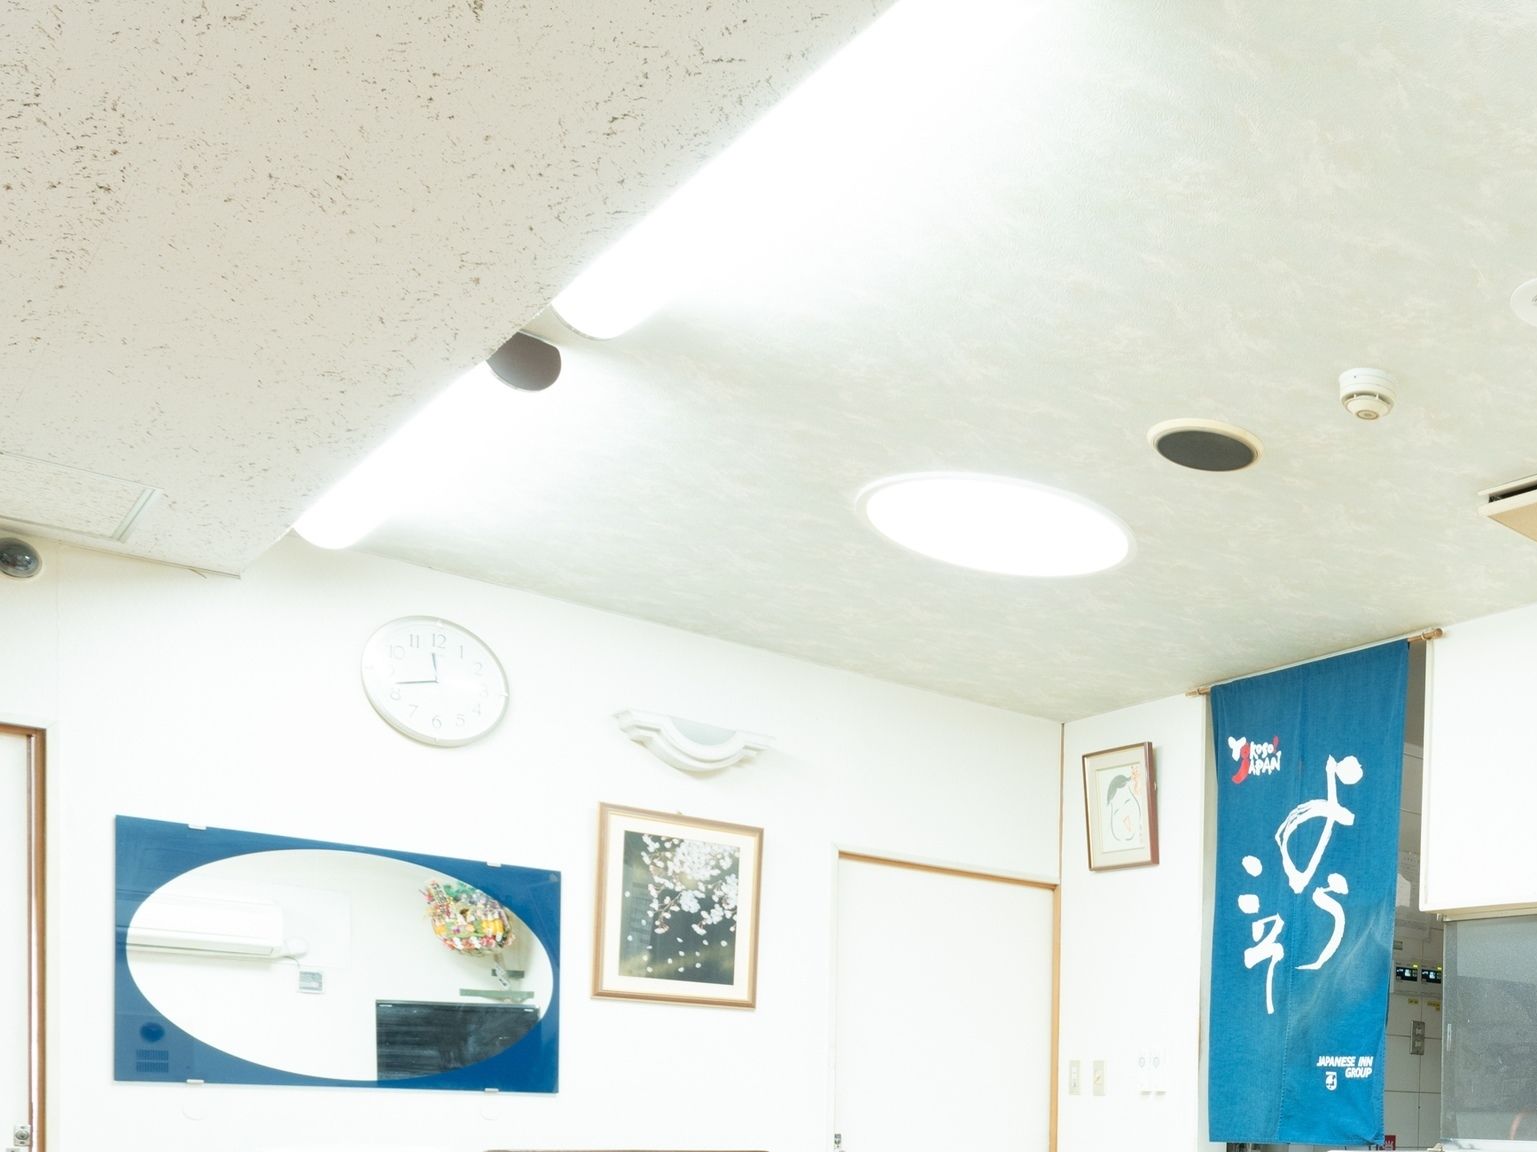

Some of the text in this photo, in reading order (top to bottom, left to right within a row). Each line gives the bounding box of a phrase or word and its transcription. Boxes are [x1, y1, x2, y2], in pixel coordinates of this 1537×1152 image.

[409, 634, 419, 648] 11
[432, 632, 447, 649] 12
[1316, 1055, 1373, 1067] JAPANESE INN
[1345, 1067, 1373, 1079] GROUP
